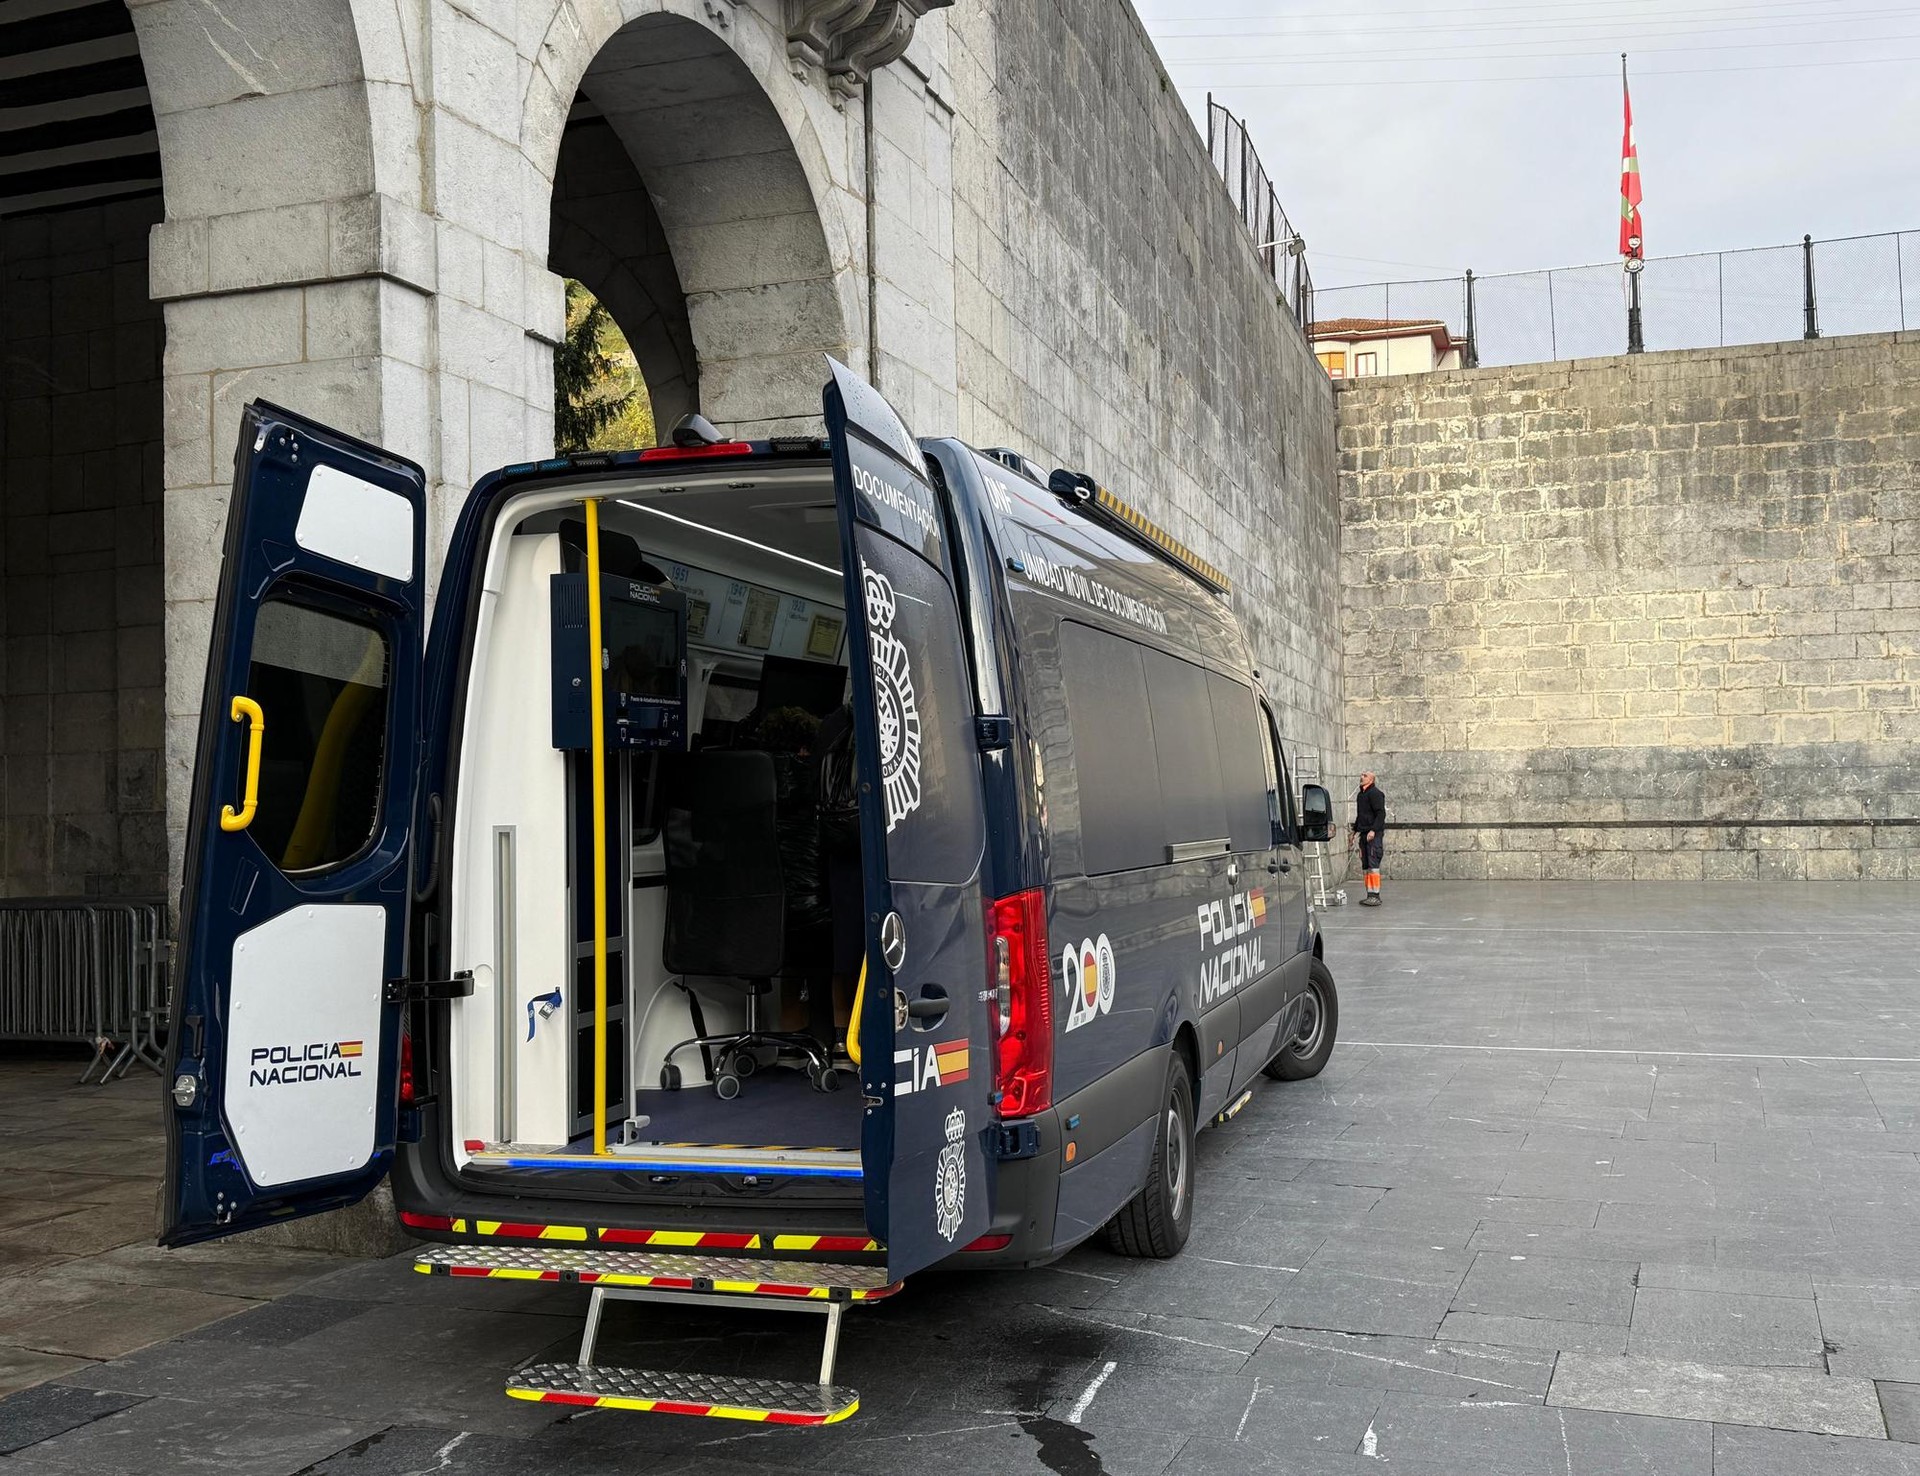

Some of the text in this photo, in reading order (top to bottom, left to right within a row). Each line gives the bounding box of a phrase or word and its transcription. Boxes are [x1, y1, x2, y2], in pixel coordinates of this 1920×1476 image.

[1020, 549, 1168, 635] UNIDAD MÓVIL DE DOCUMENTACIÓN
[1062, 932, 1116, 1034] 200
[1198, 935, 1266, 1009] NACIONAL
[249, 1060, 362, 1087] NACIONAL
